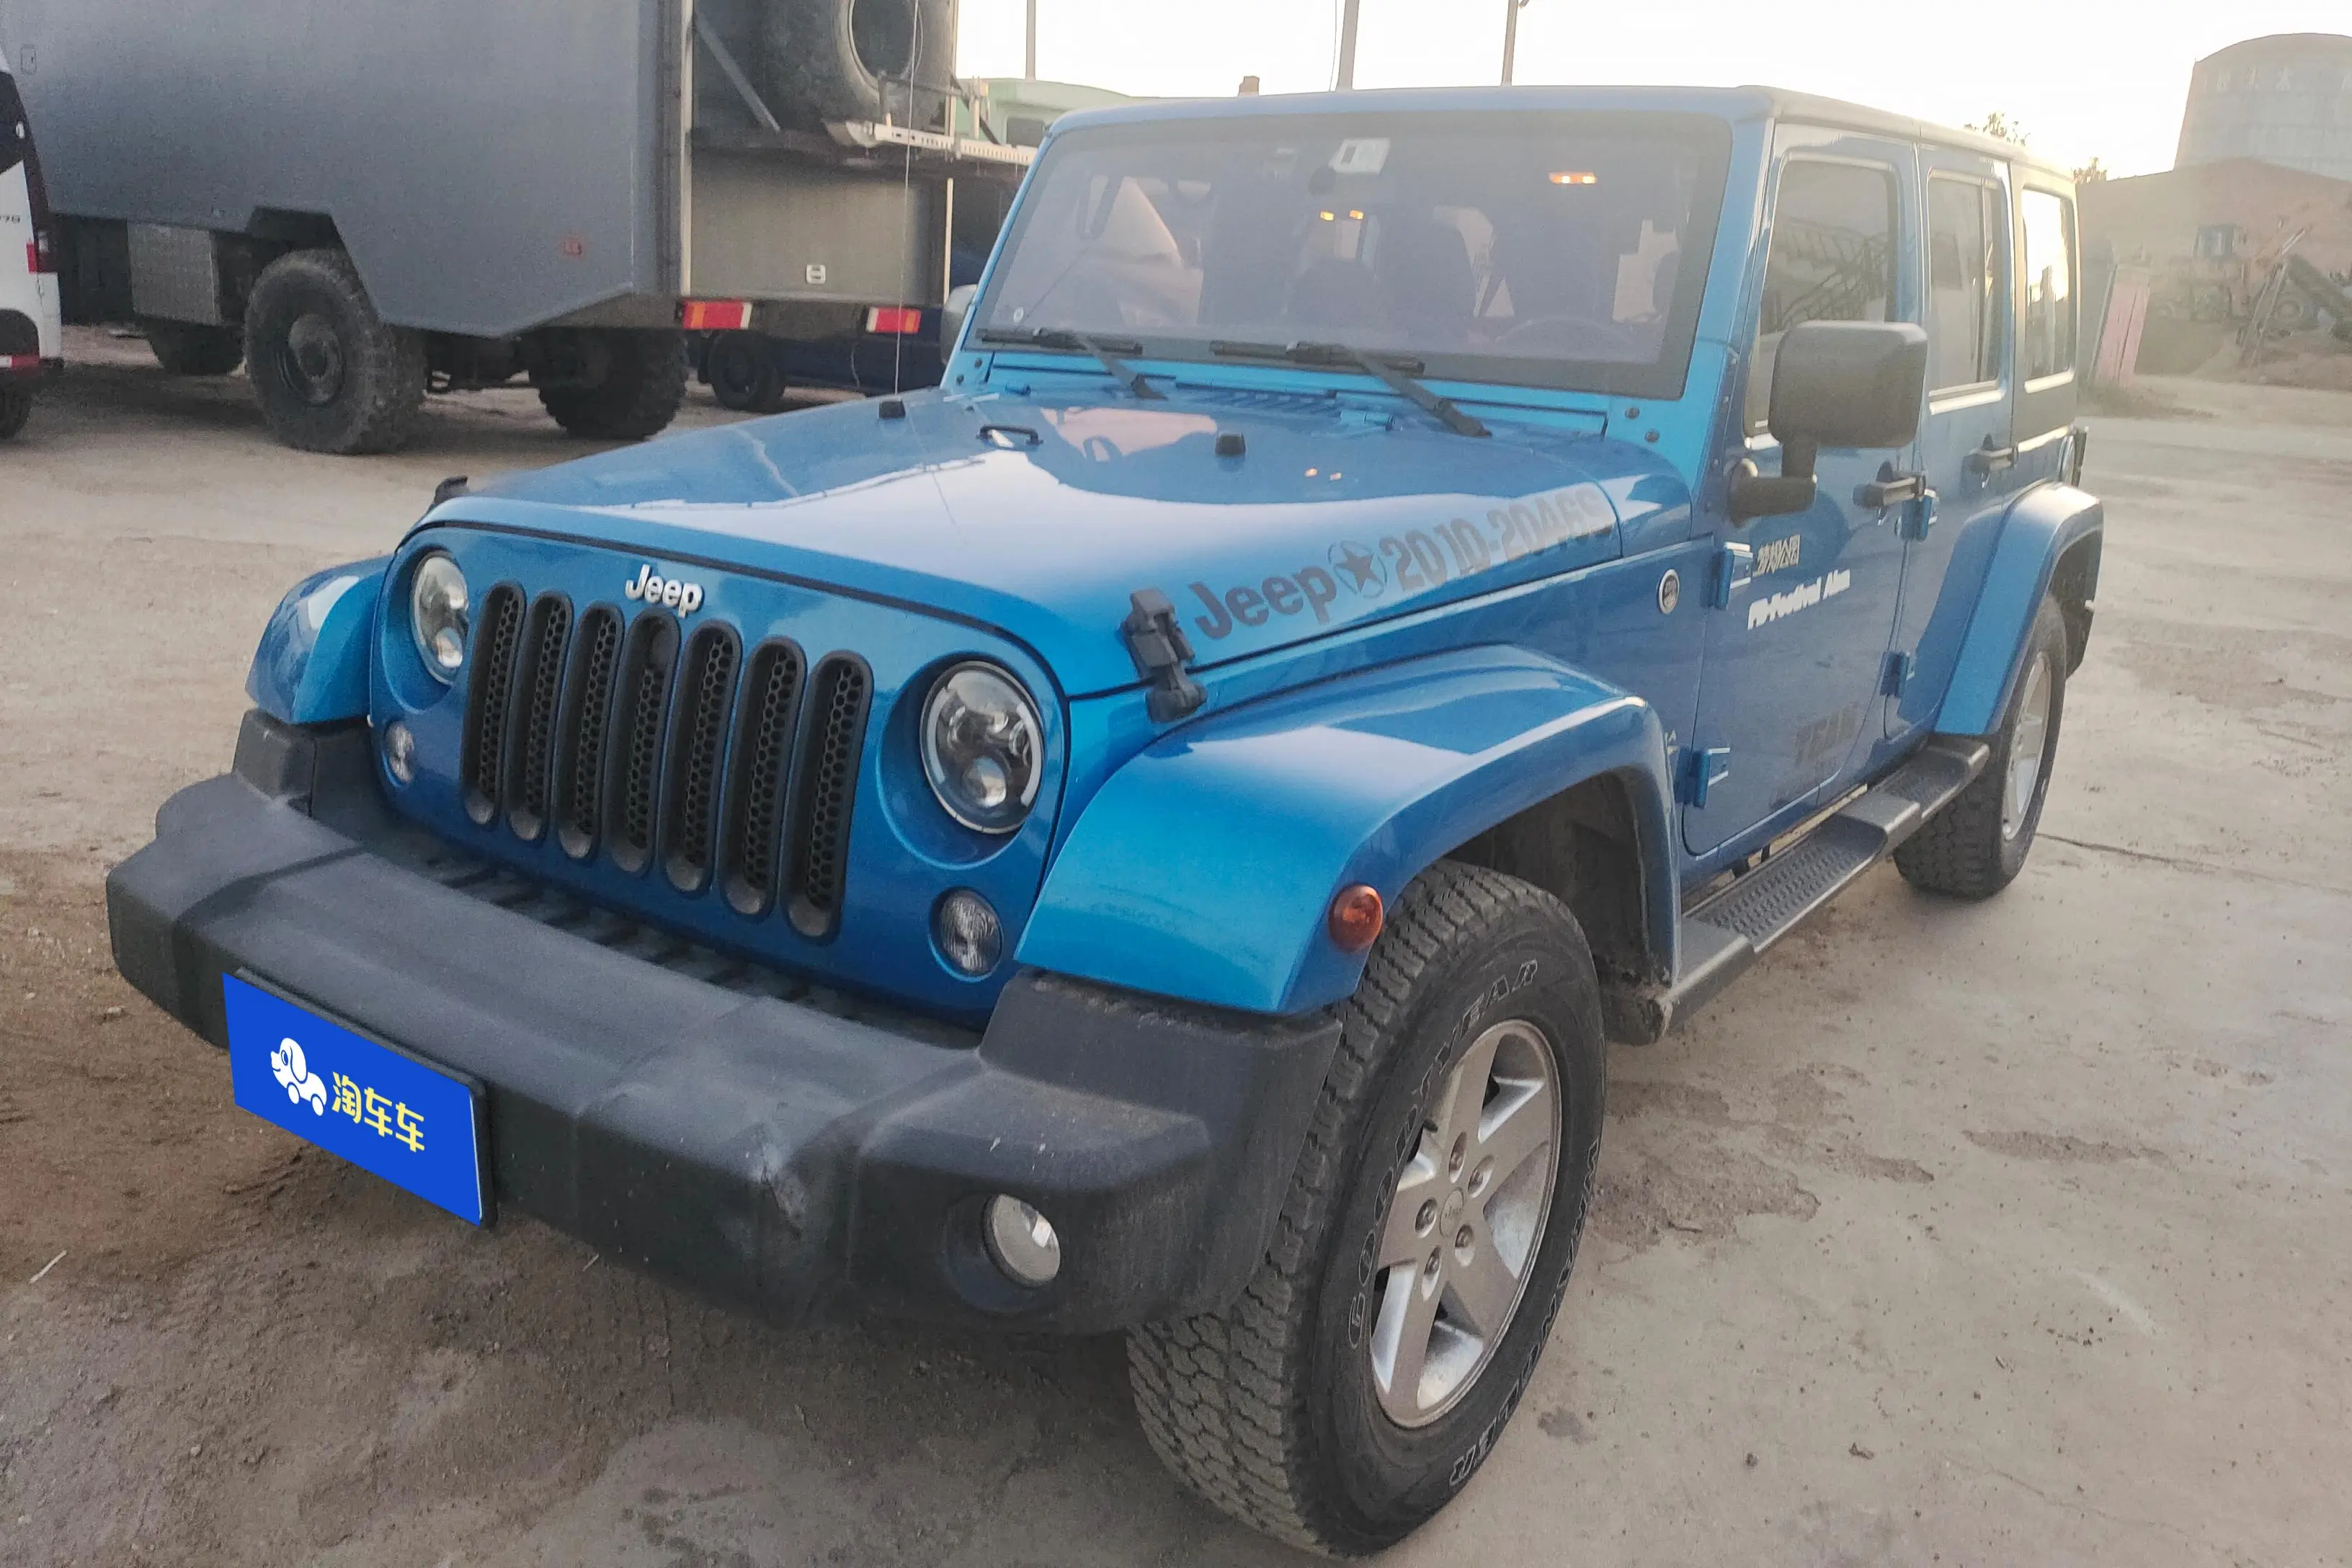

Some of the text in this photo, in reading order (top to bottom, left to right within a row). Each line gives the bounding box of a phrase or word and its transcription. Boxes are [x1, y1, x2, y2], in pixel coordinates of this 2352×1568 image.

[625, 564, 704, 619] Jeep
[1188, 566, 1338, 640] Jeep
[1348, 959, 1539, 1350] GOODYEAR
